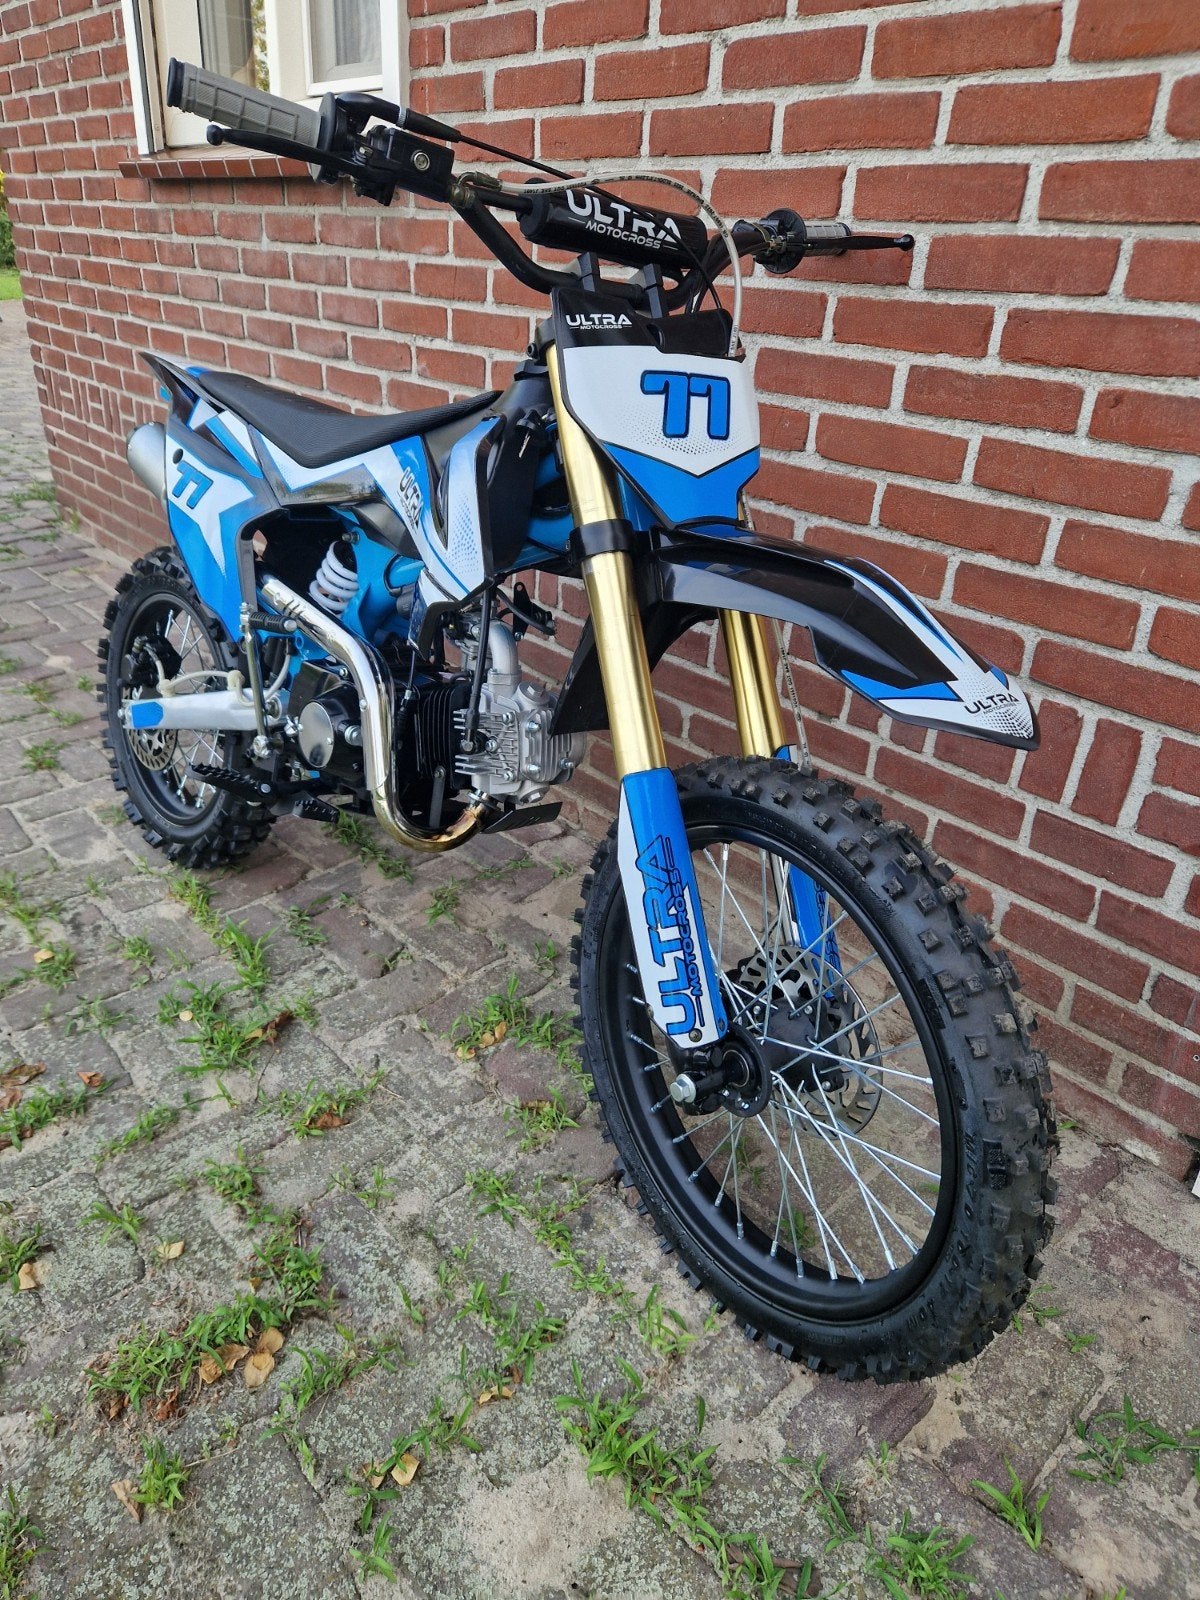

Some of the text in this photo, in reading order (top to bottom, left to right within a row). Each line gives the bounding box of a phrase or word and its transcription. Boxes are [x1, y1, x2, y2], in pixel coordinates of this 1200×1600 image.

[566, 190, 682, 243] ULTRA
[585, 220, 662, 249] MOTOCROSS
[565, 313, 633, 326] ULTRA
[640, 369, 731, 441] 77
[172, 460, 214, 510] 77
[964, 693, 1020, 715] ULTRA
[635, 834, 697, 1036] ULTRA
[669, 867, 704, 997] MOTOCROSS
